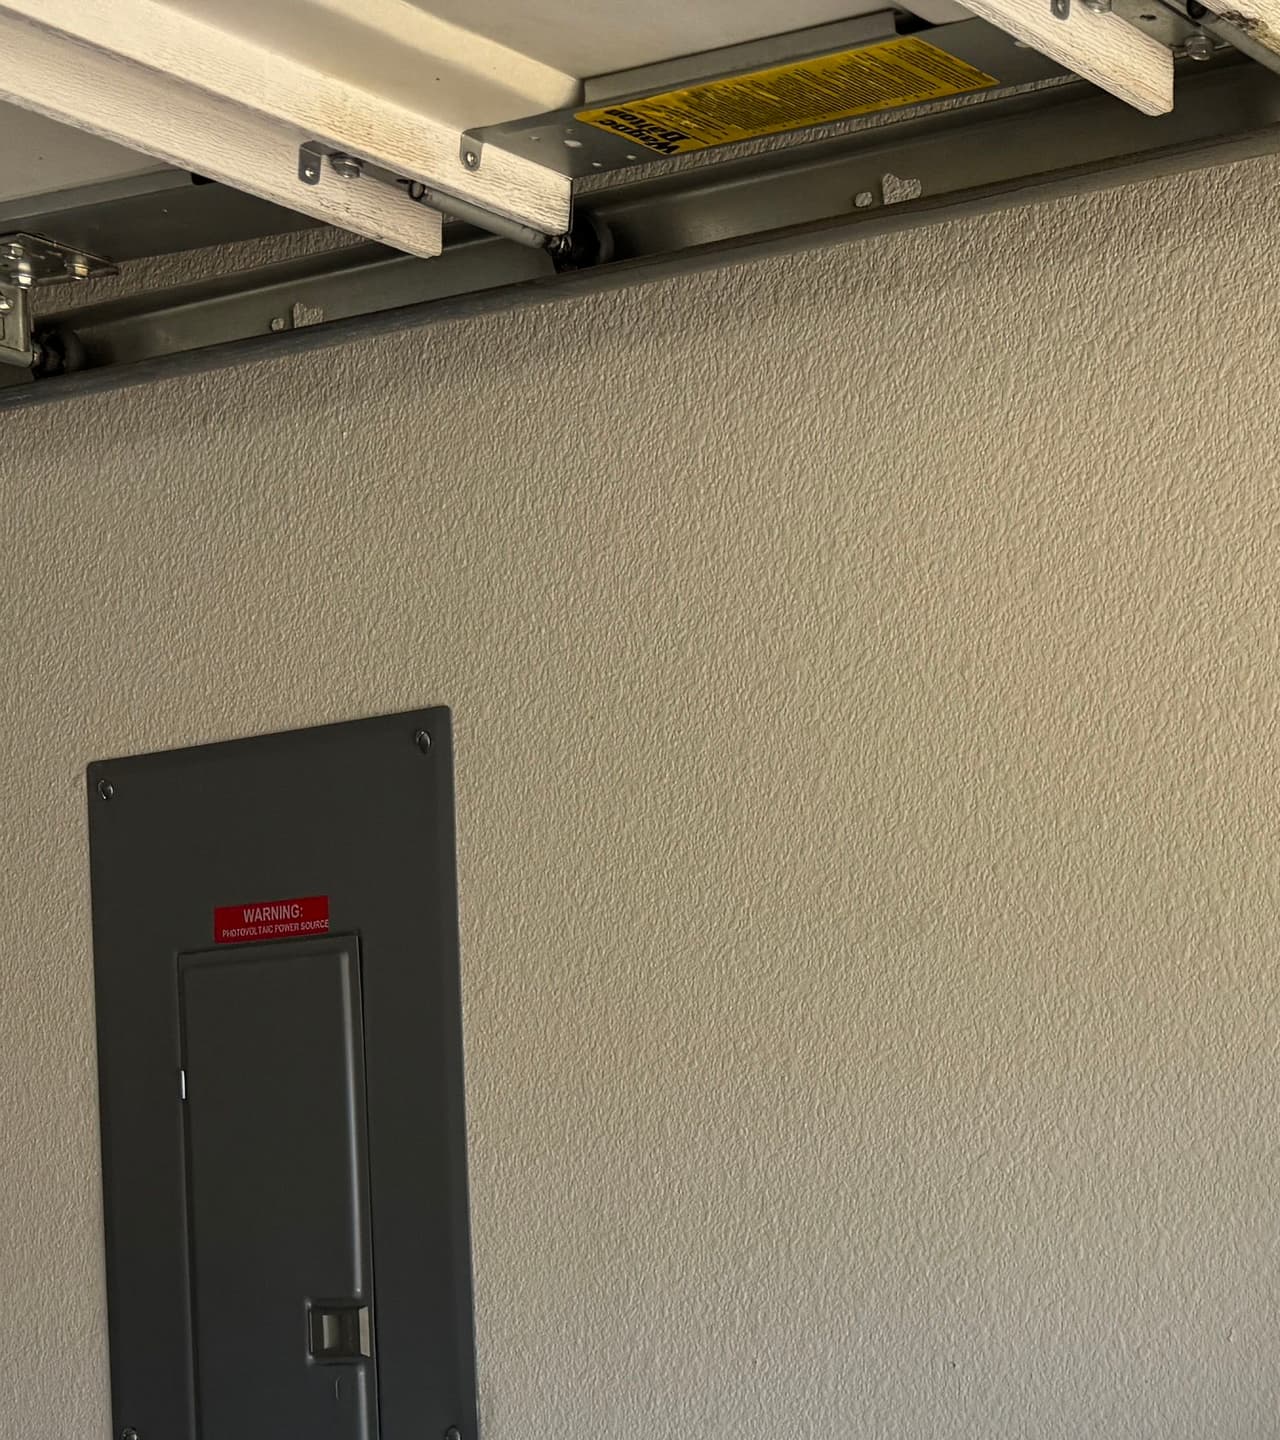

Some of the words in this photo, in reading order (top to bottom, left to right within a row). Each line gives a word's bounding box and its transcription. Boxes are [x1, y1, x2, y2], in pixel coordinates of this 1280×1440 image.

[243, 904, 304, 924] WARNING:
[222, 925, 274, 938] PHOTOVOLTAIC
[274, 922, 299, 933] POWER
[300, 920, 329, 930] SOURCE
